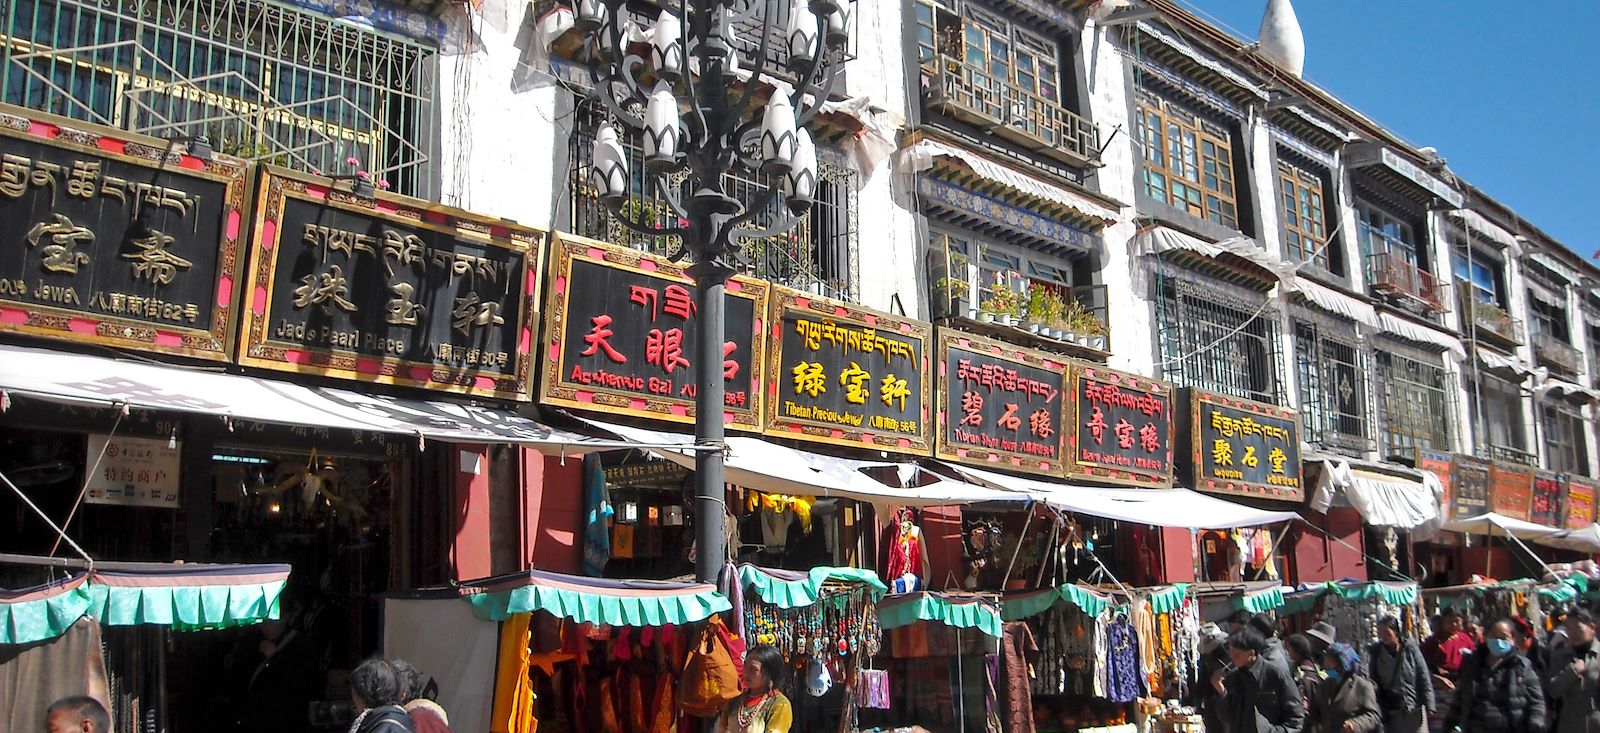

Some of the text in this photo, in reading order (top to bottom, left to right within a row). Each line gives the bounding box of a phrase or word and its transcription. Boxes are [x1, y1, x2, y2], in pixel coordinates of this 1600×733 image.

[276, 319, 405, 354] Jade Pearl Place
[648, 375, 673, 396] Gzi
[792, 360, 911, 412] 绿宝轩
[784, 401, 811, 418] Tibetan
[959, 391, 1055, 439] 碧石缘
[1086, 406, 1161, 453] 奇宝缘
[1213, 439, 1288, 474] 聚石堂
[104, 466, 166, 483] 特约商户
